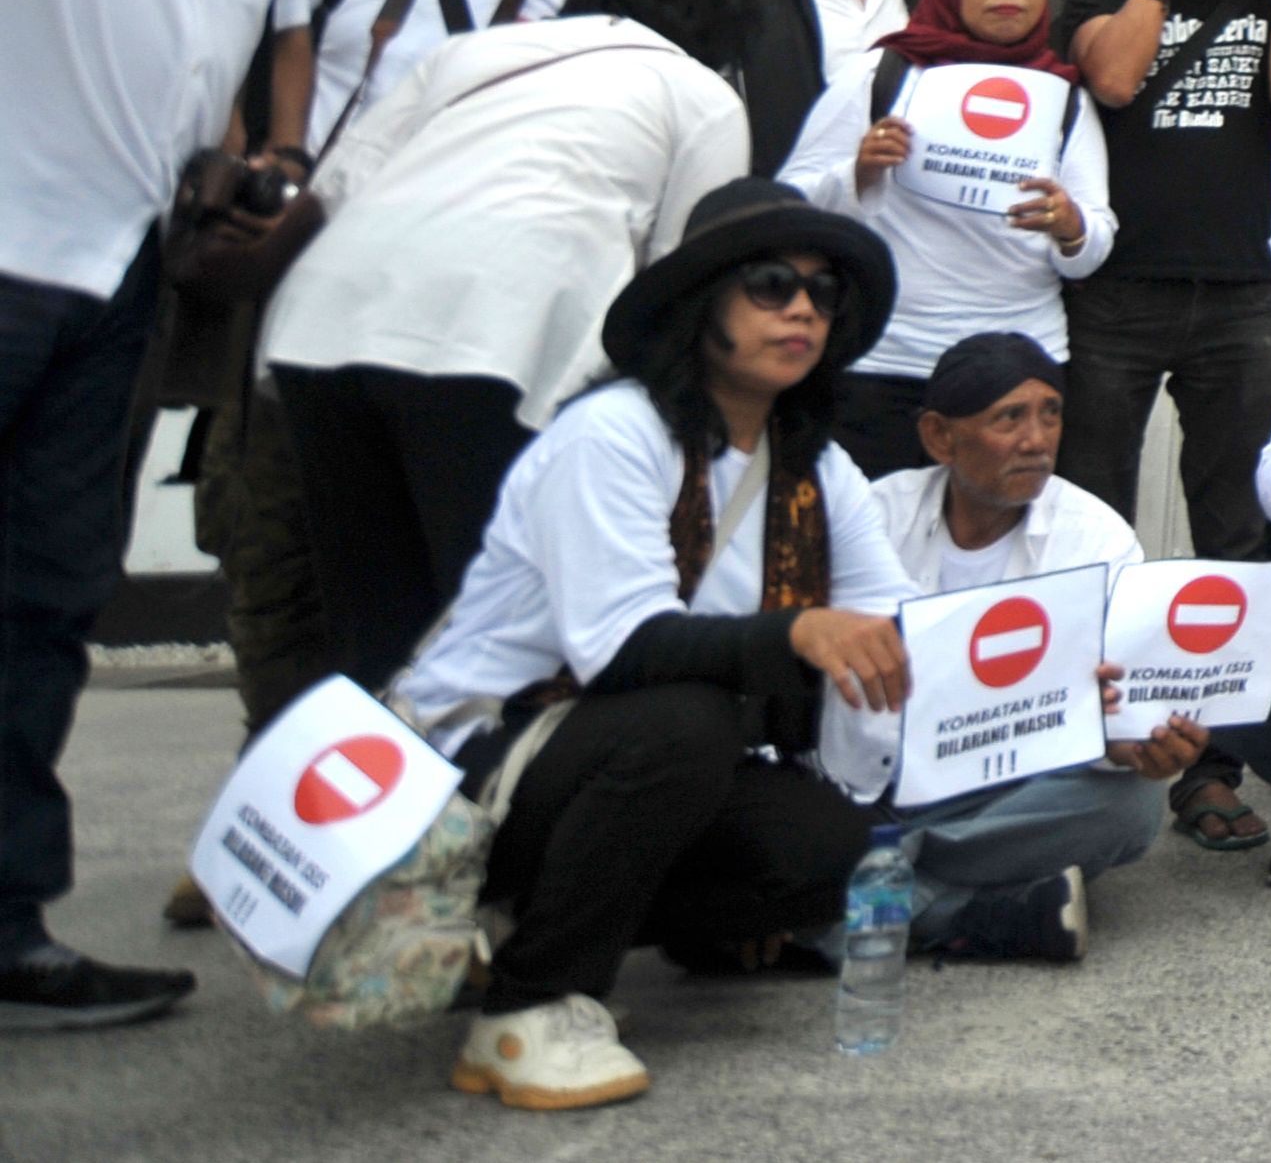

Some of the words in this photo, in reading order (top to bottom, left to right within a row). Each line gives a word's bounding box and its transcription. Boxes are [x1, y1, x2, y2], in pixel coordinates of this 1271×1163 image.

[922, 159, 984, 179] DILARANG
[925, 143, 1008, 164] KOMBATAN
[1013, 158, 1038, 170] ISIS
[1129, 665, 1222, 681] KOMBATAN
[1225, 660, 1254, 674] ISIS
[1128, 686, 1199, 703] DILARANG
[1202, 679, 1247, 698] MASUK
[937, 698, 1034, 734] KOMBATAN
[1038, 687, 1067, 707] ISIS
[937, 725, 1009, 759] DILARANG
[1013, 711, 1064, 737] MASUK
